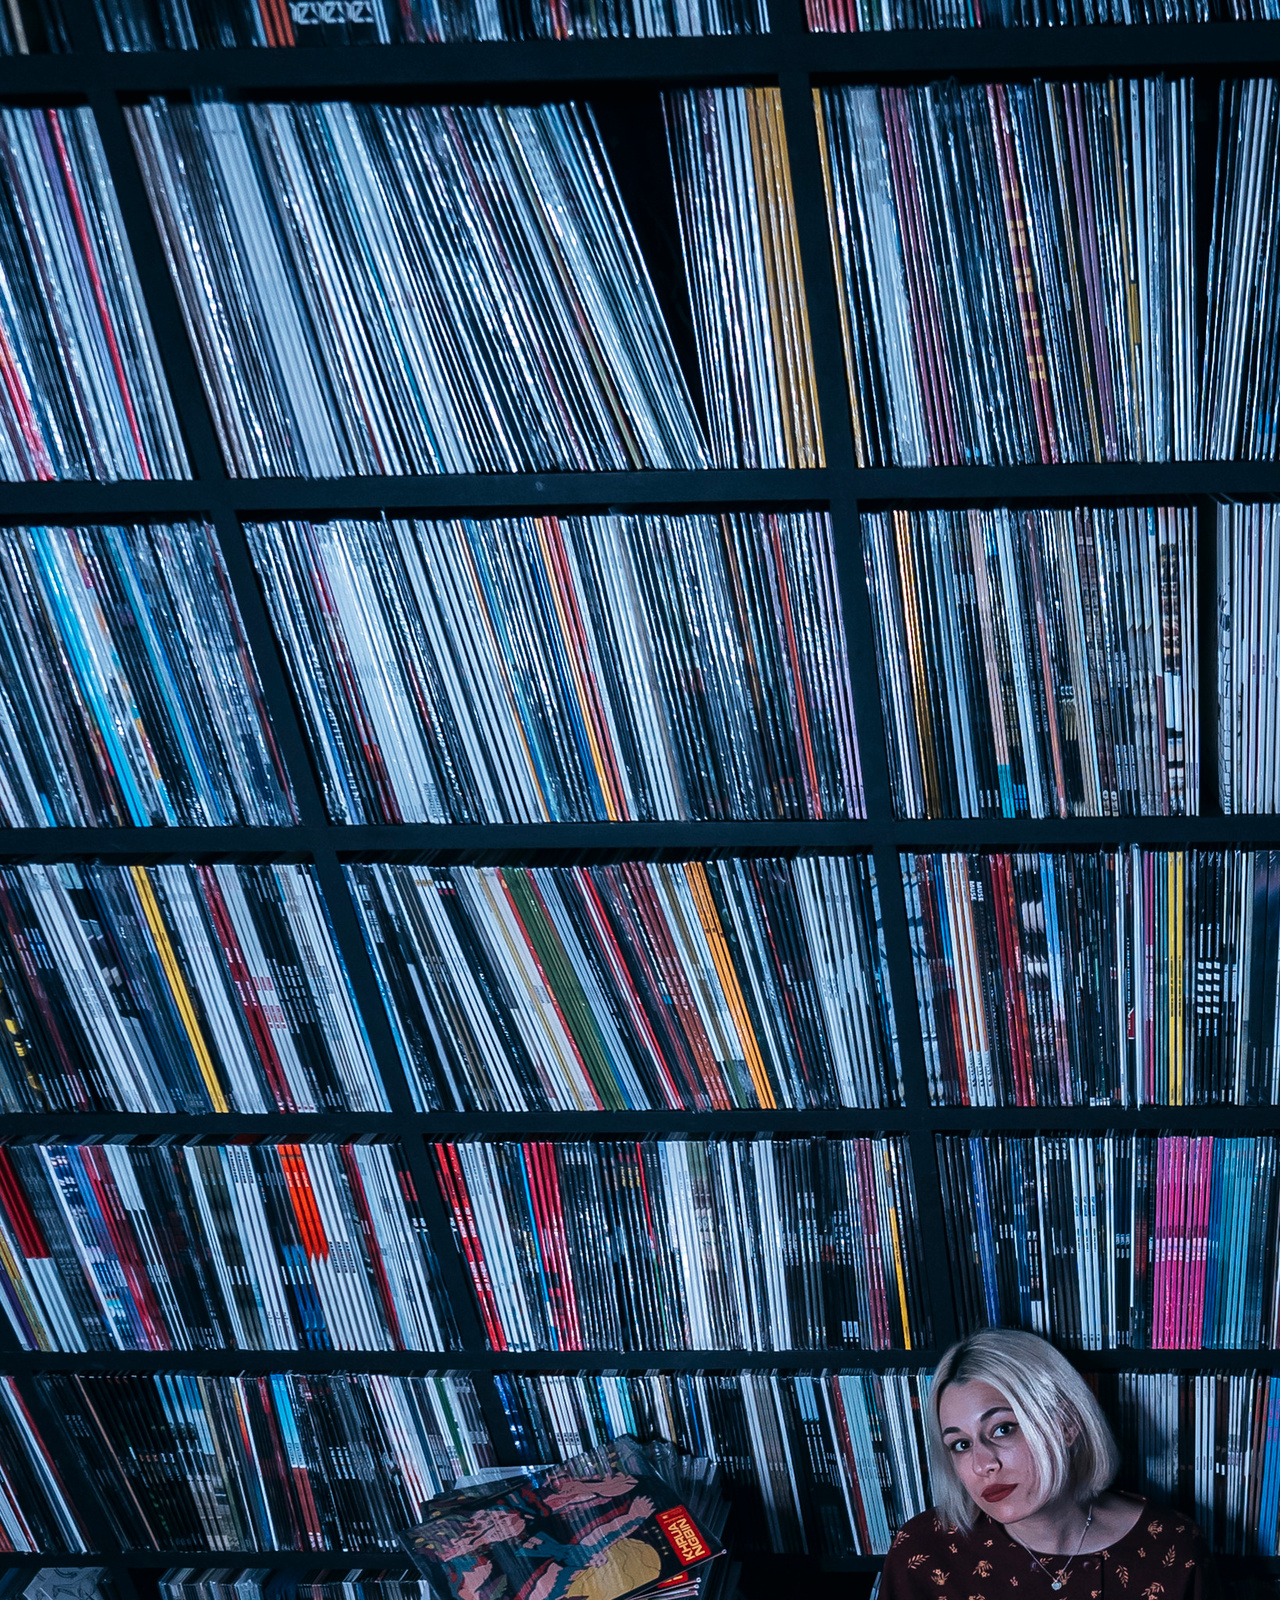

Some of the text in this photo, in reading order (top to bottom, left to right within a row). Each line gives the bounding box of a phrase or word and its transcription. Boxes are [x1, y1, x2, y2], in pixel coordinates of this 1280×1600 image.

[969, 880, 977, 901] MUSE
[976, 881, 984, 902] MUSE
[668, 1522, 695, 1561] KHRUA
[677, 1518, 706, 1557] NGBIN
